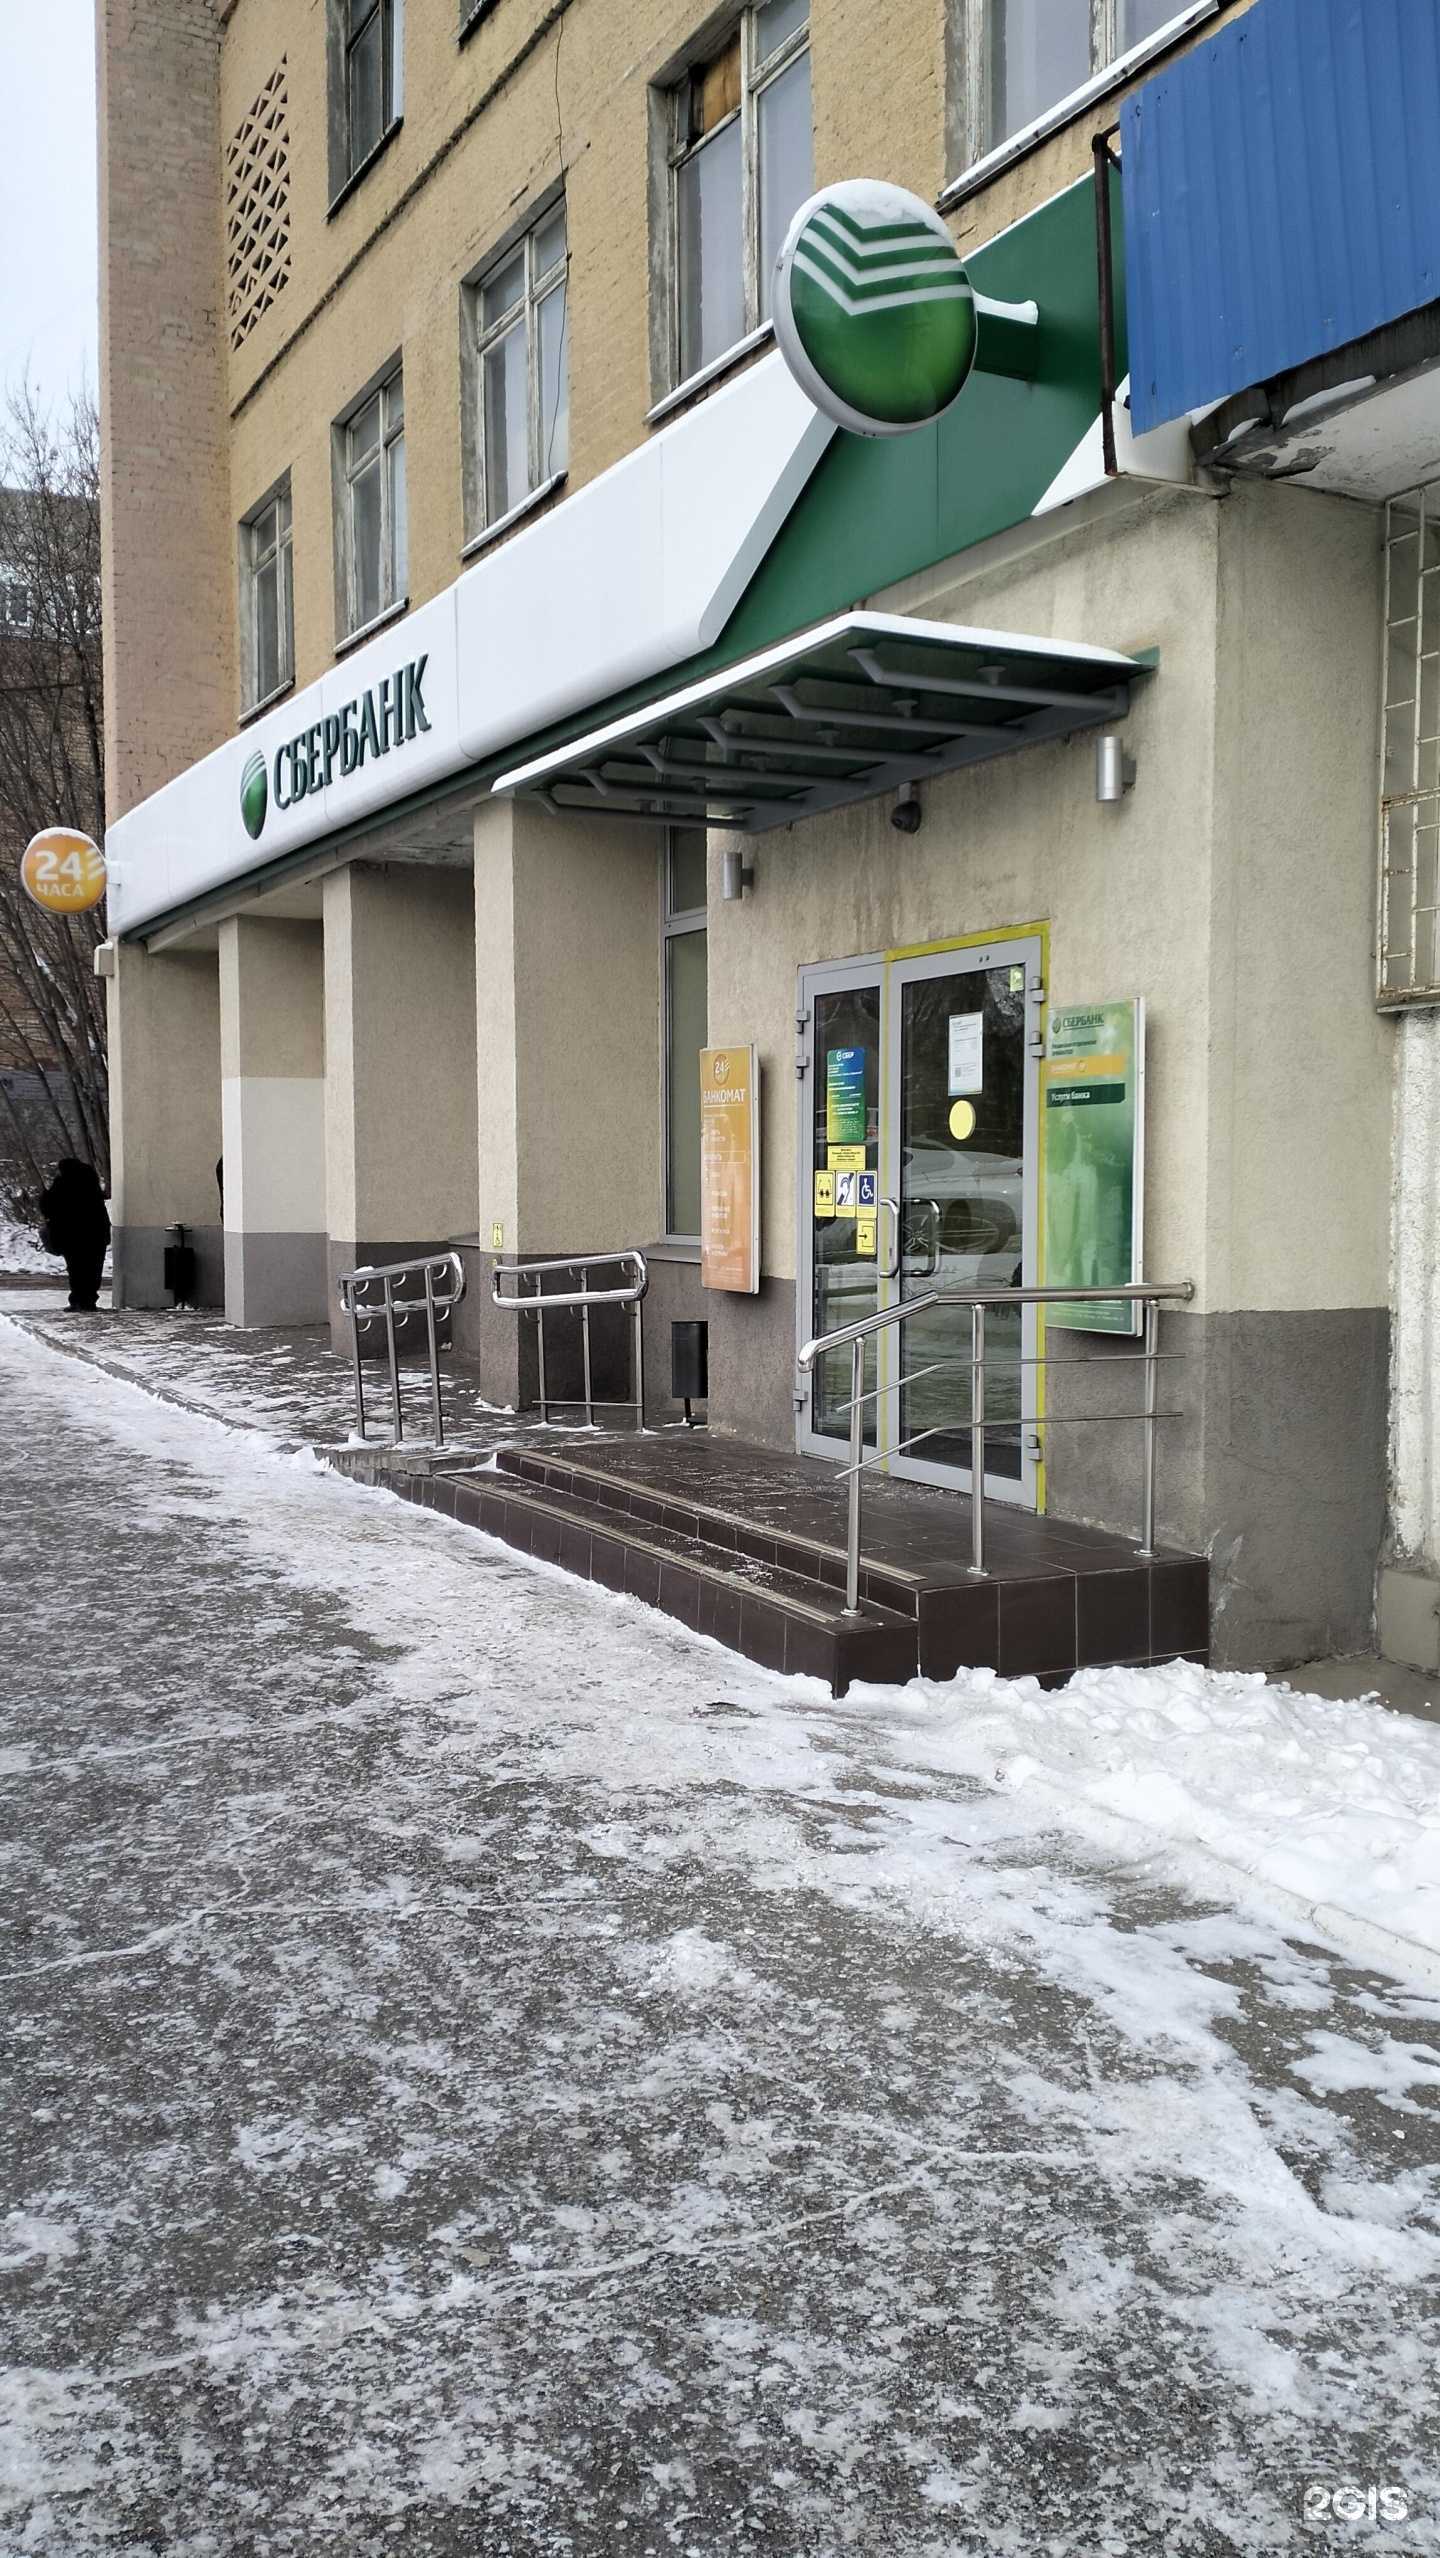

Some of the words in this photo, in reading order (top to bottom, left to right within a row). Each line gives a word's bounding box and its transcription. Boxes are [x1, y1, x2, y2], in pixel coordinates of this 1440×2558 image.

[272, 653, 432, 811] СБЕРБАНК
[34, 849, 82, 881] 24
[36, 882, 85, 897] ЧАСА
[1063, 1013, 1105, 1028] СБЕРБАНК
[703, 1088, 746, 1105] БАНКОМАТ
